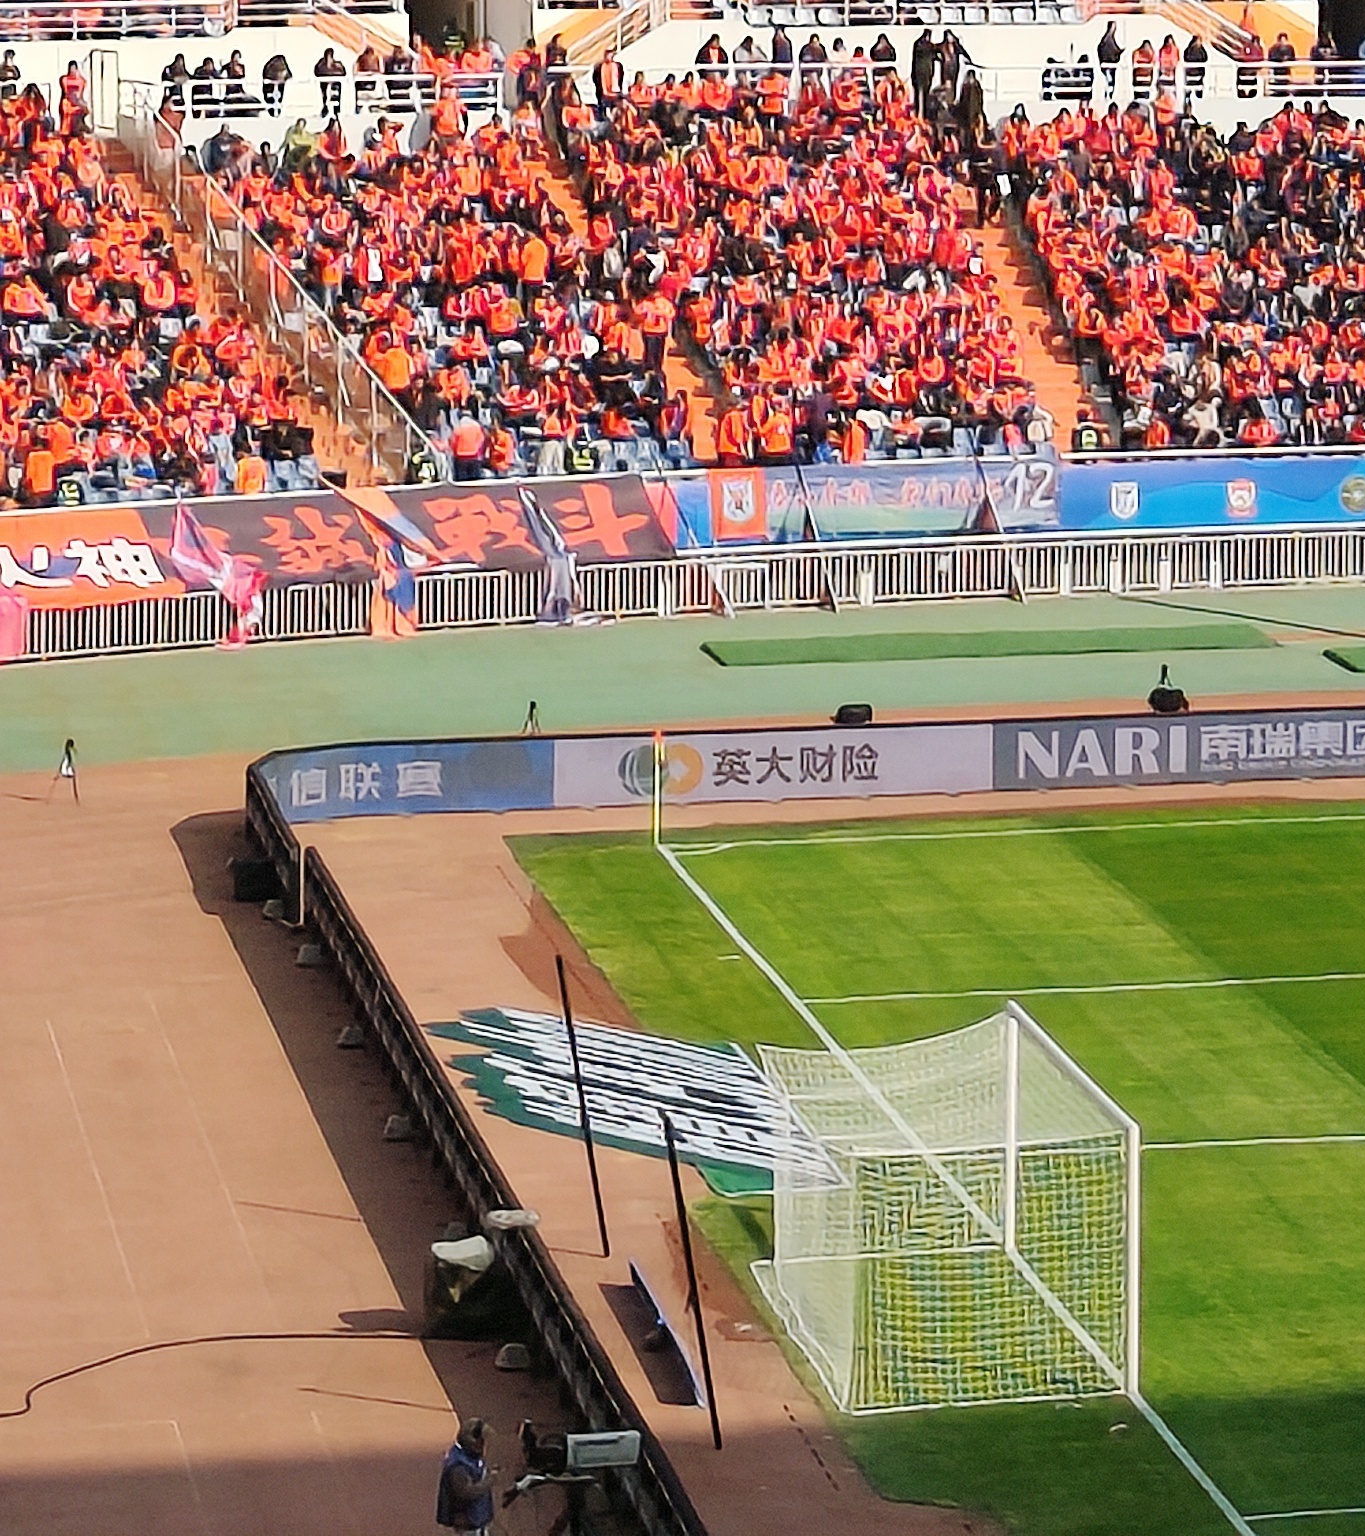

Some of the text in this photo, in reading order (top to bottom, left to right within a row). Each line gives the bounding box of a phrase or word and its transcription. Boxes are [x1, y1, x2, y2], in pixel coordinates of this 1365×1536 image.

[711, 743, 881, 786] 英大财险
[1016, 724, 1189, 781] NARI
